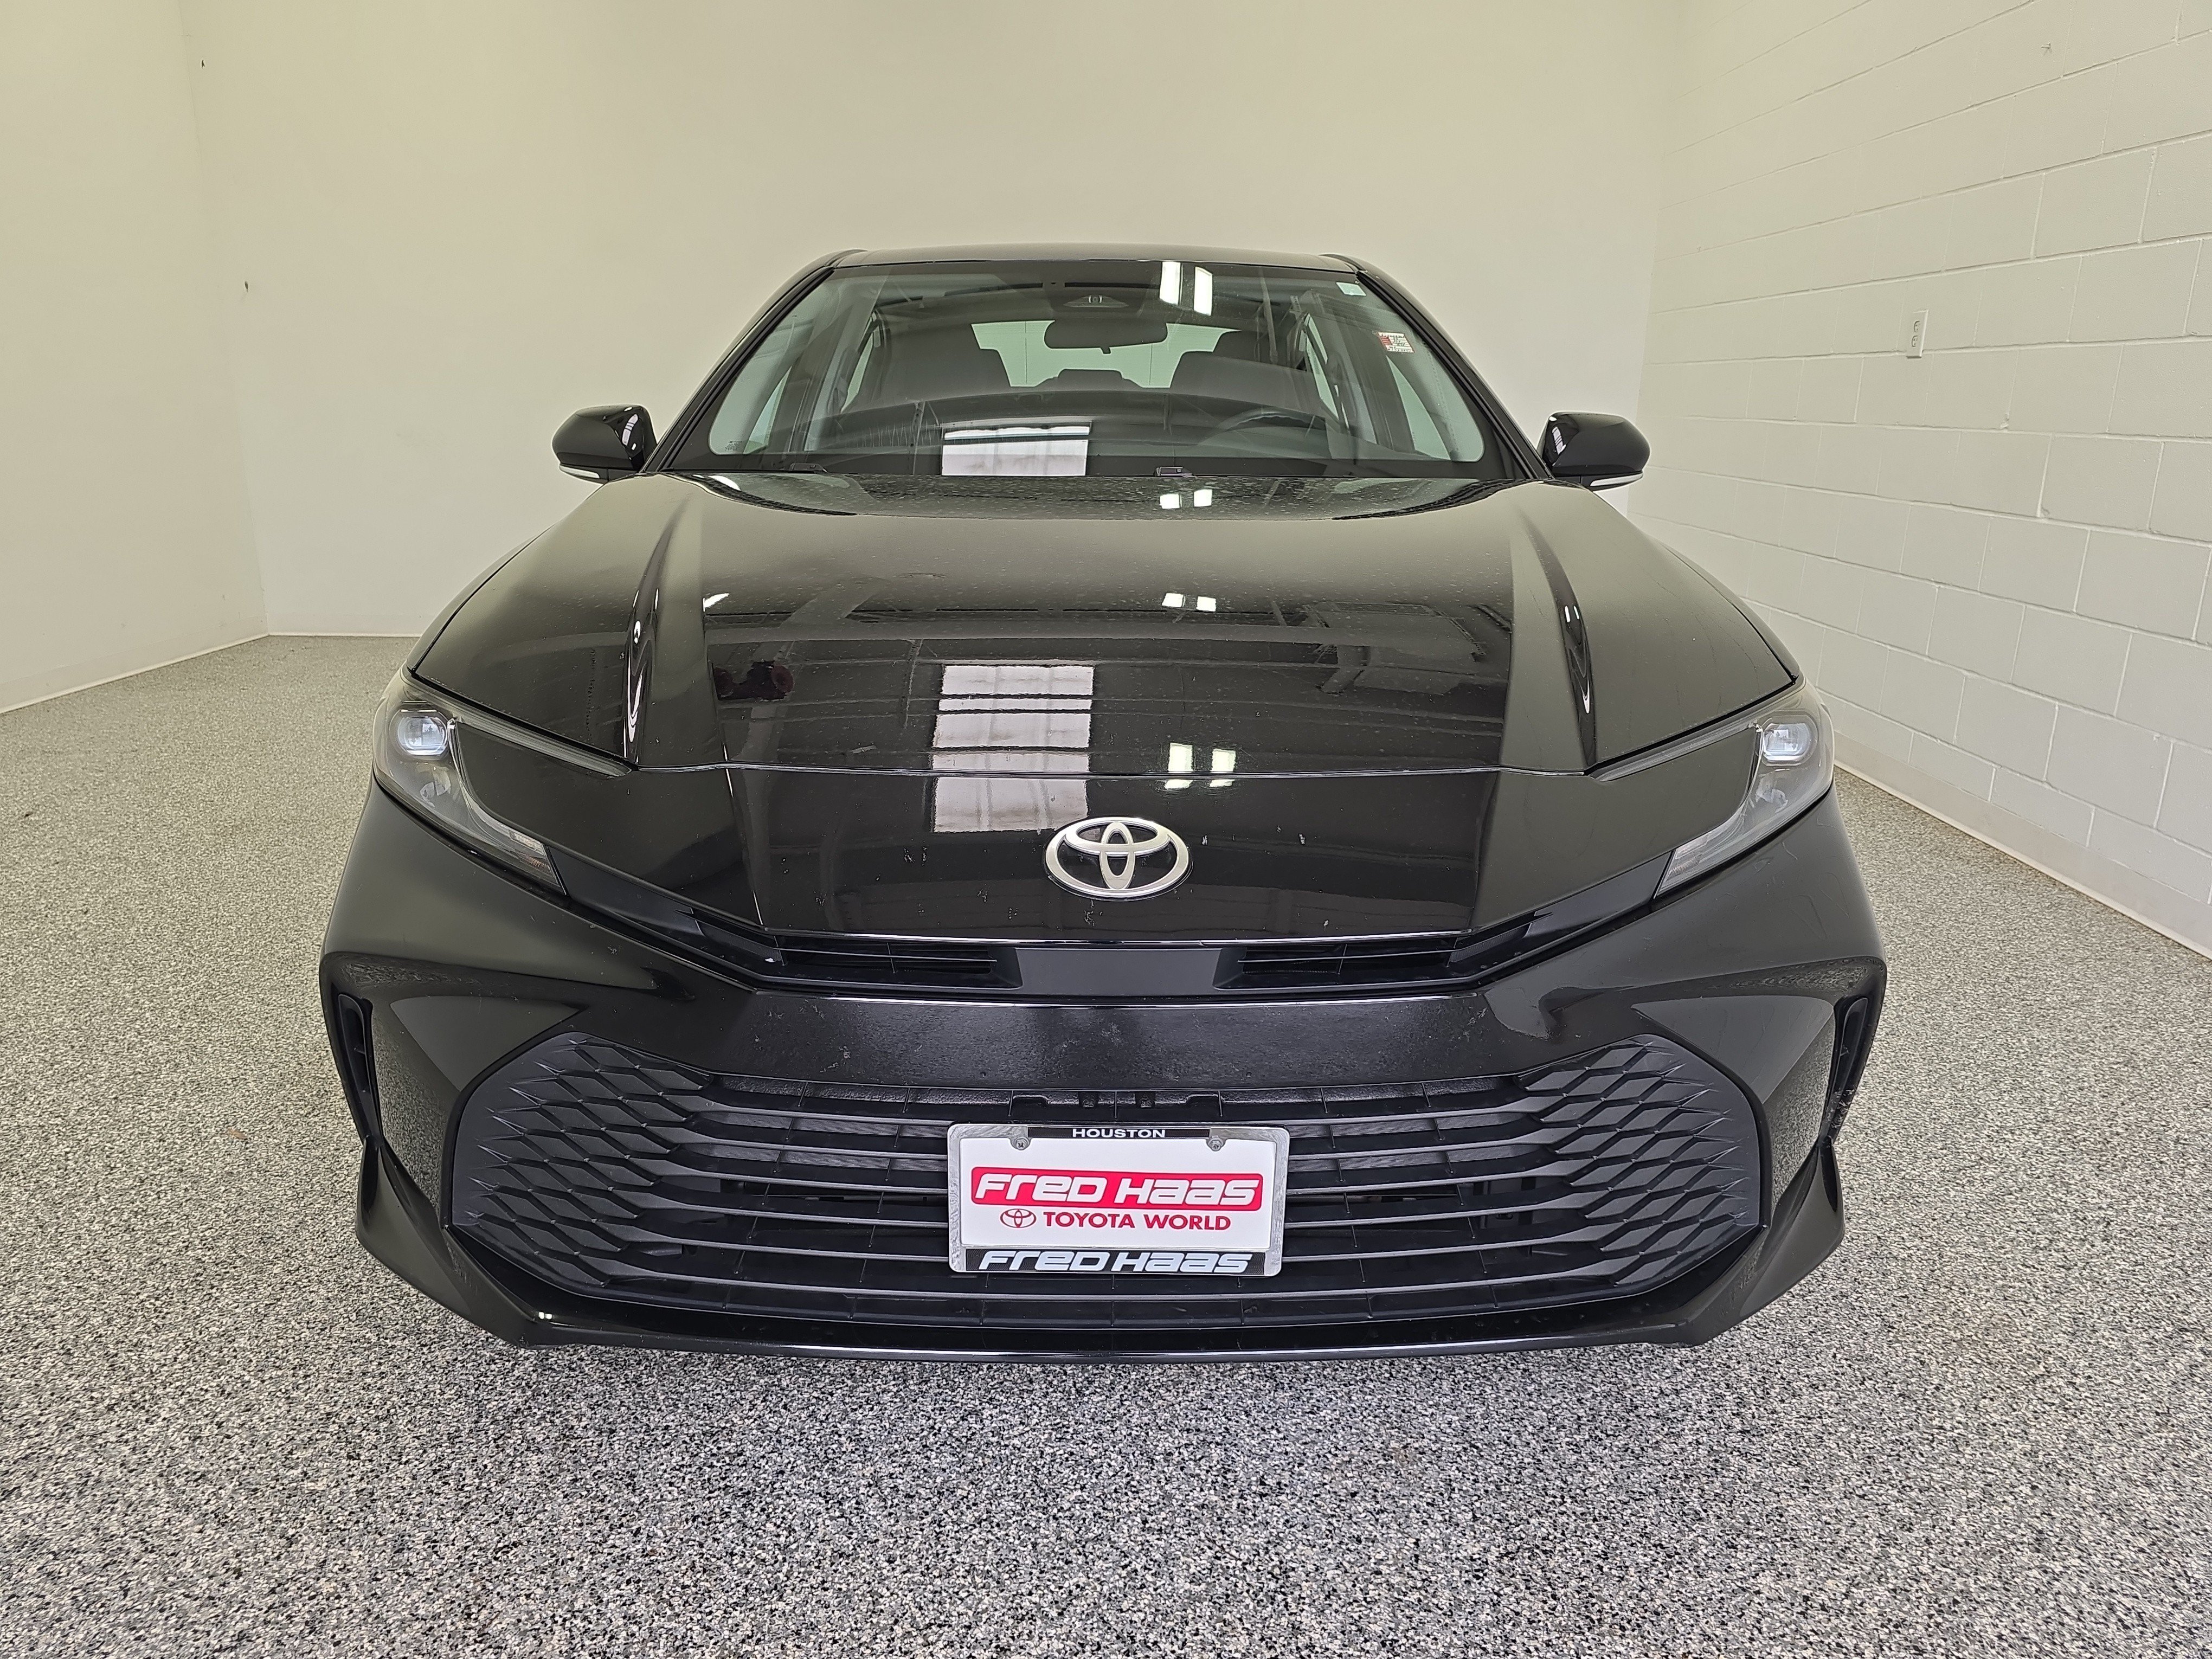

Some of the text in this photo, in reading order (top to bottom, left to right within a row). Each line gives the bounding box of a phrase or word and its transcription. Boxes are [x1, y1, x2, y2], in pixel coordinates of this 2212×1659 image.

[1072, 1129, 1166, 1138] HOUSTON
[1043, 1212, 1231, 1230] TOYOTA WORLD
